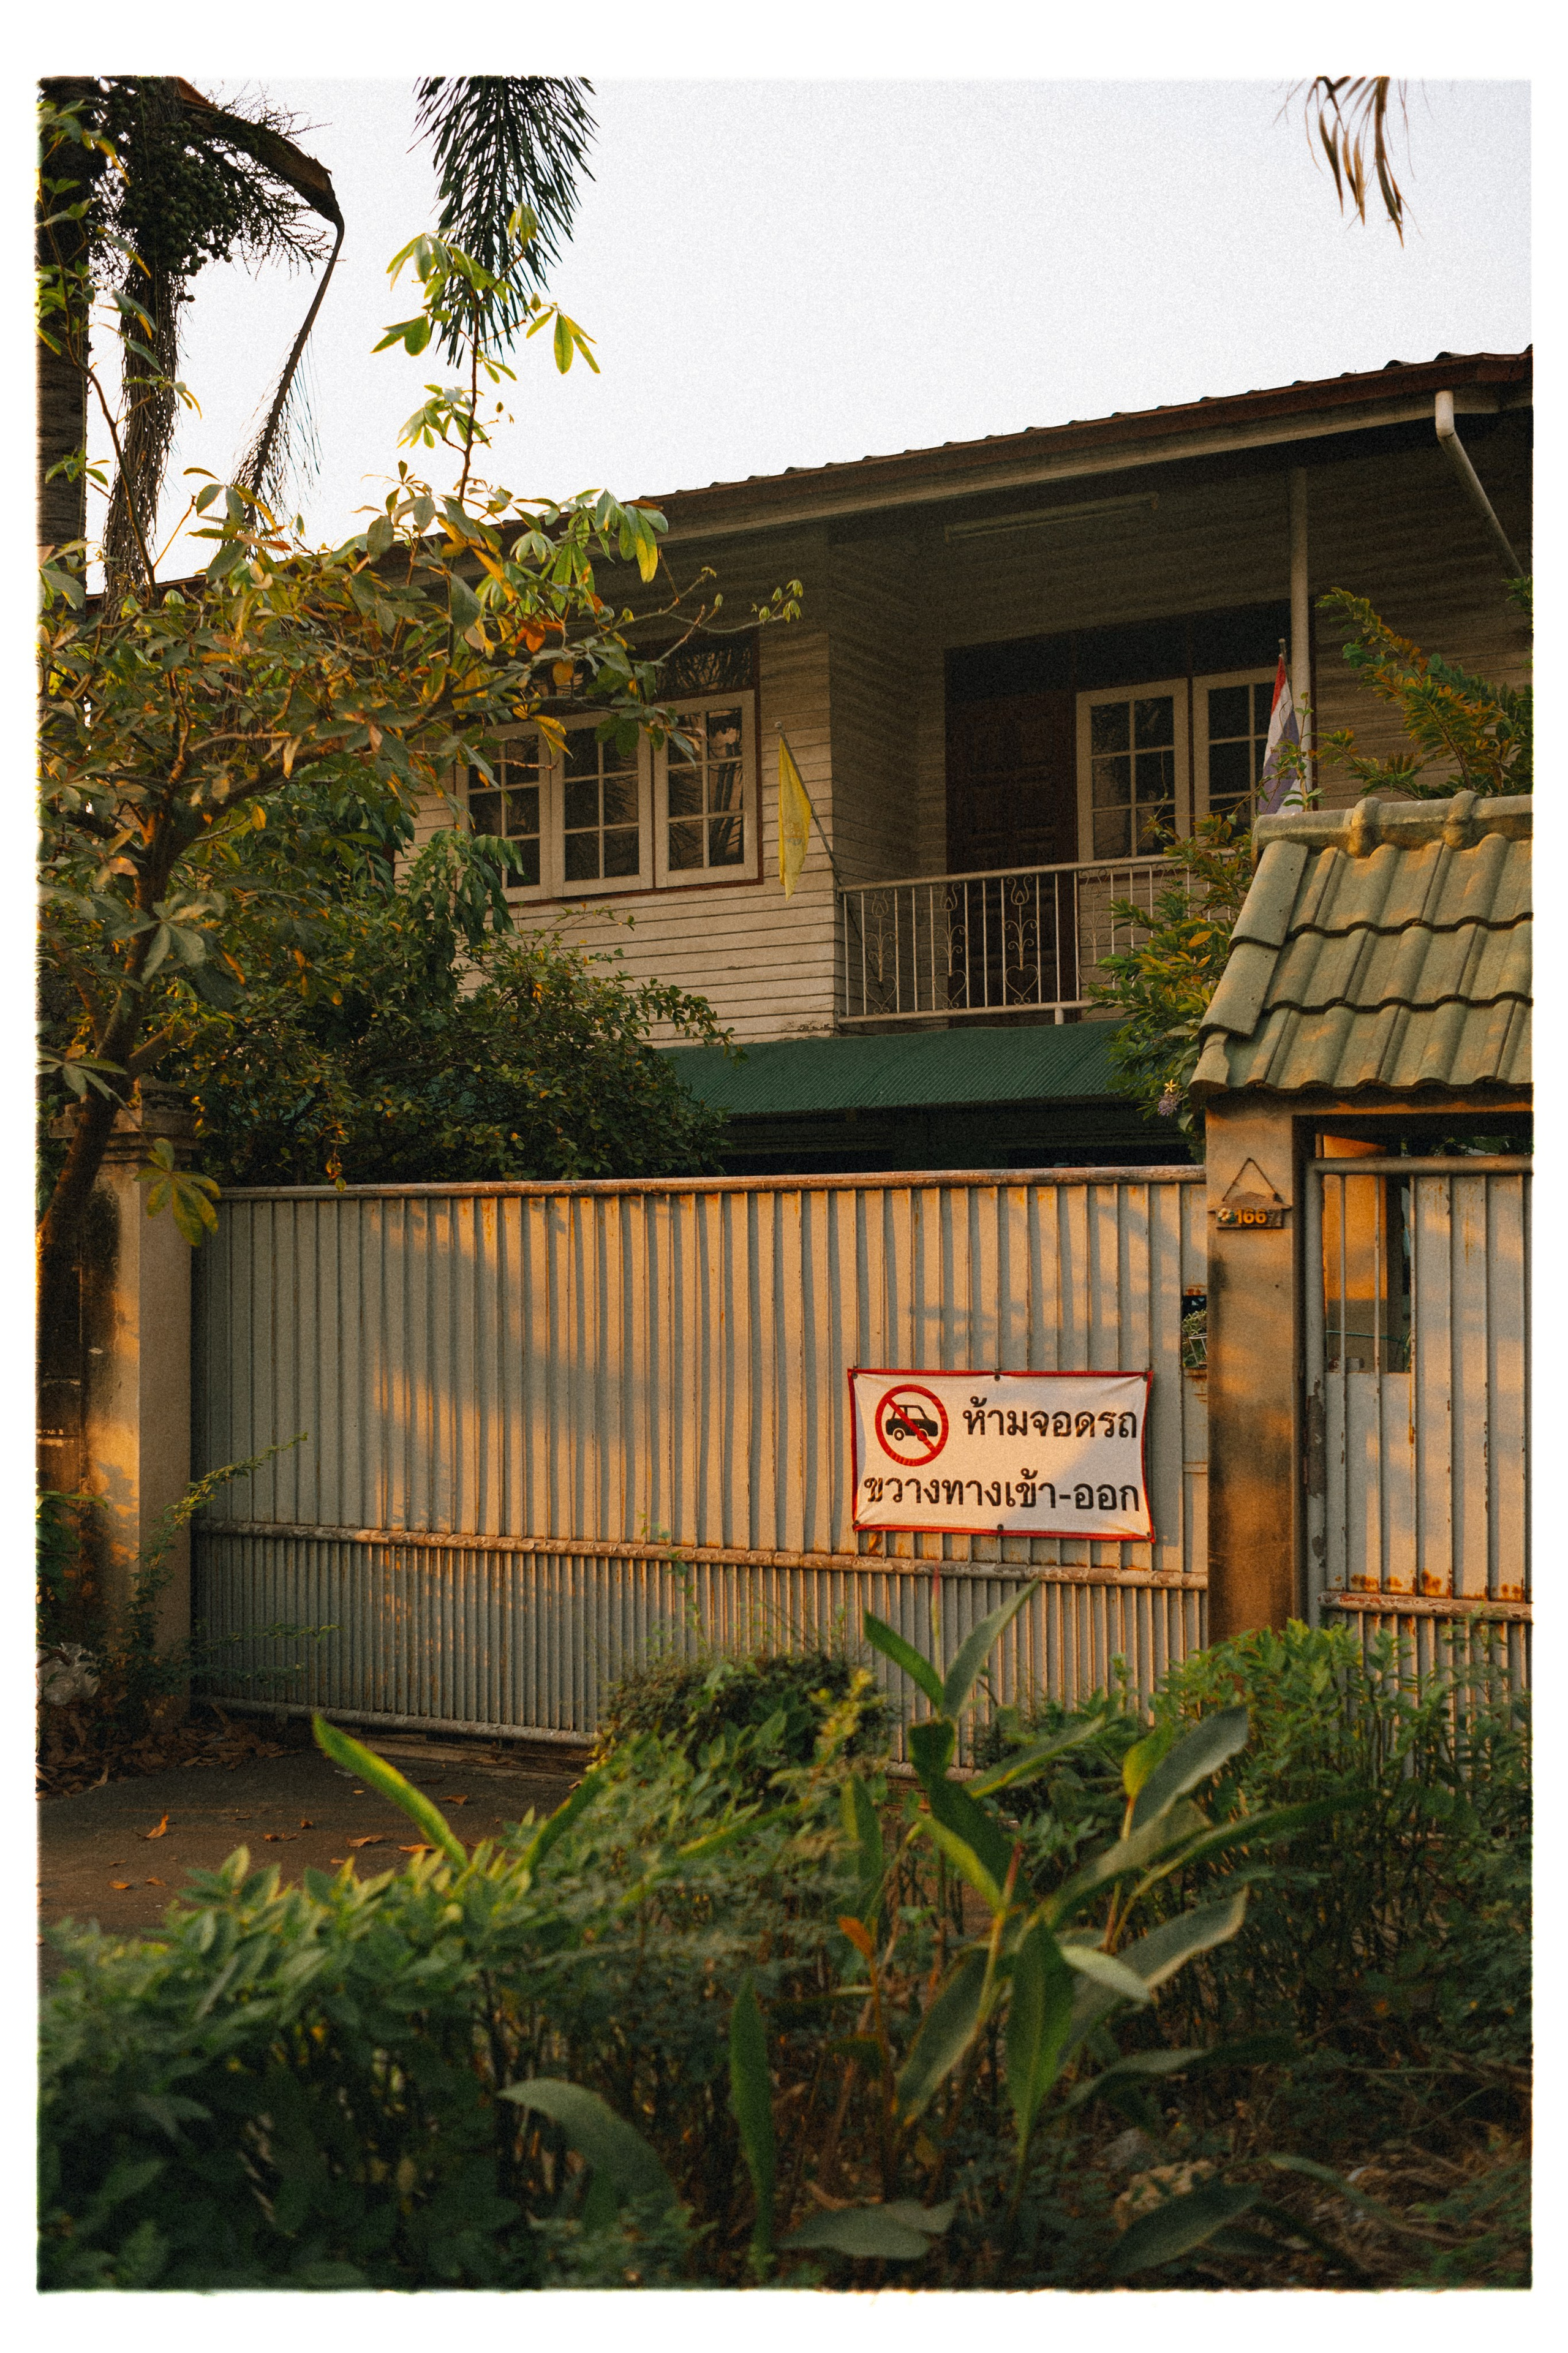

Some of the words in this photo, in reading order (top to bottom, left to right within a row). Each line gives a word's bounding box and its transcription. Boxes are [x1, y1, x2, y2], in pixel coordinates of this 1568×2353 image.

[962, 1396, 1137, 1438] ห้ามจอดรถ
[864, 1468, 1140, 1512] ขวางทางเข้า-ออก
